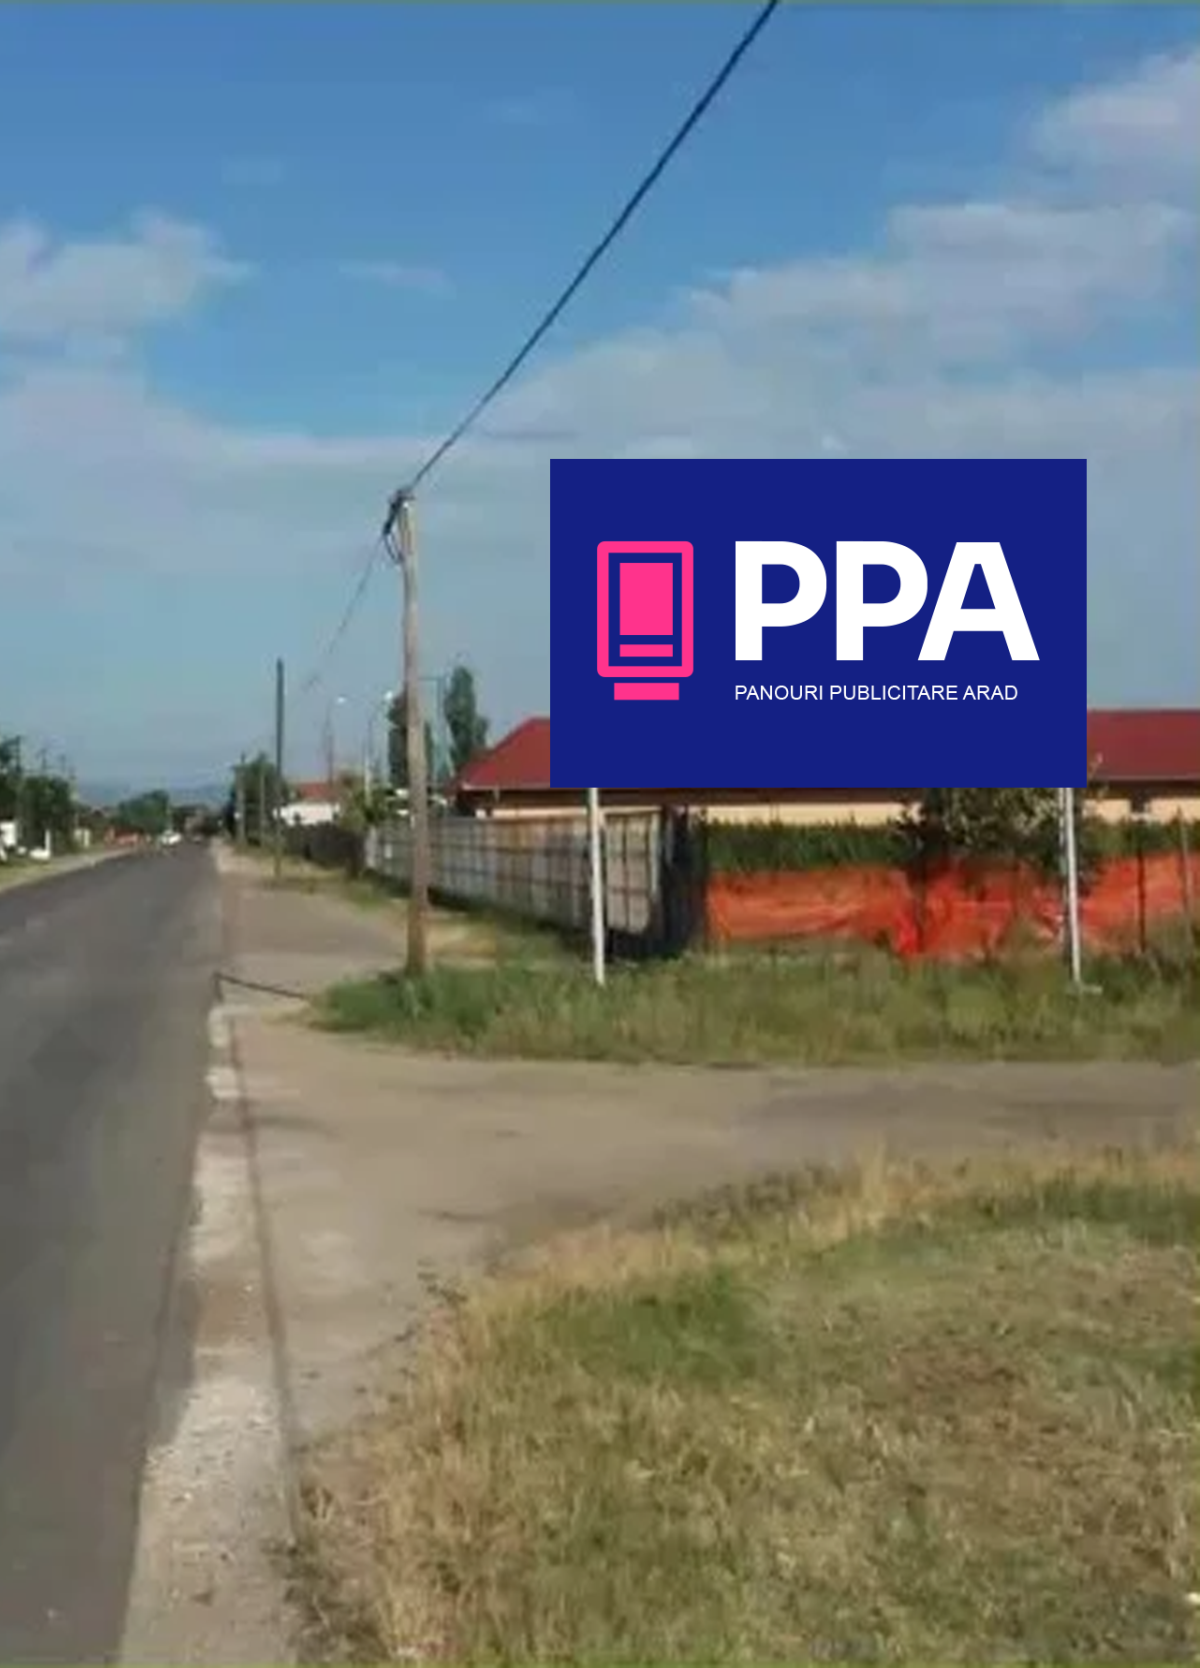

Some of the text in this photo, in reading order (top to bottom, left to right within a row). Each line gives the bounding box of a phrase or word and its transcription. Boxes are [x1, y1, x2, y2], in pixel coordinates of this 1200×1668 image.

[735, 541, 1040, 661] PPA
[735, 685, 1018, 701] PANOURI PUBLICITARE ARAD
